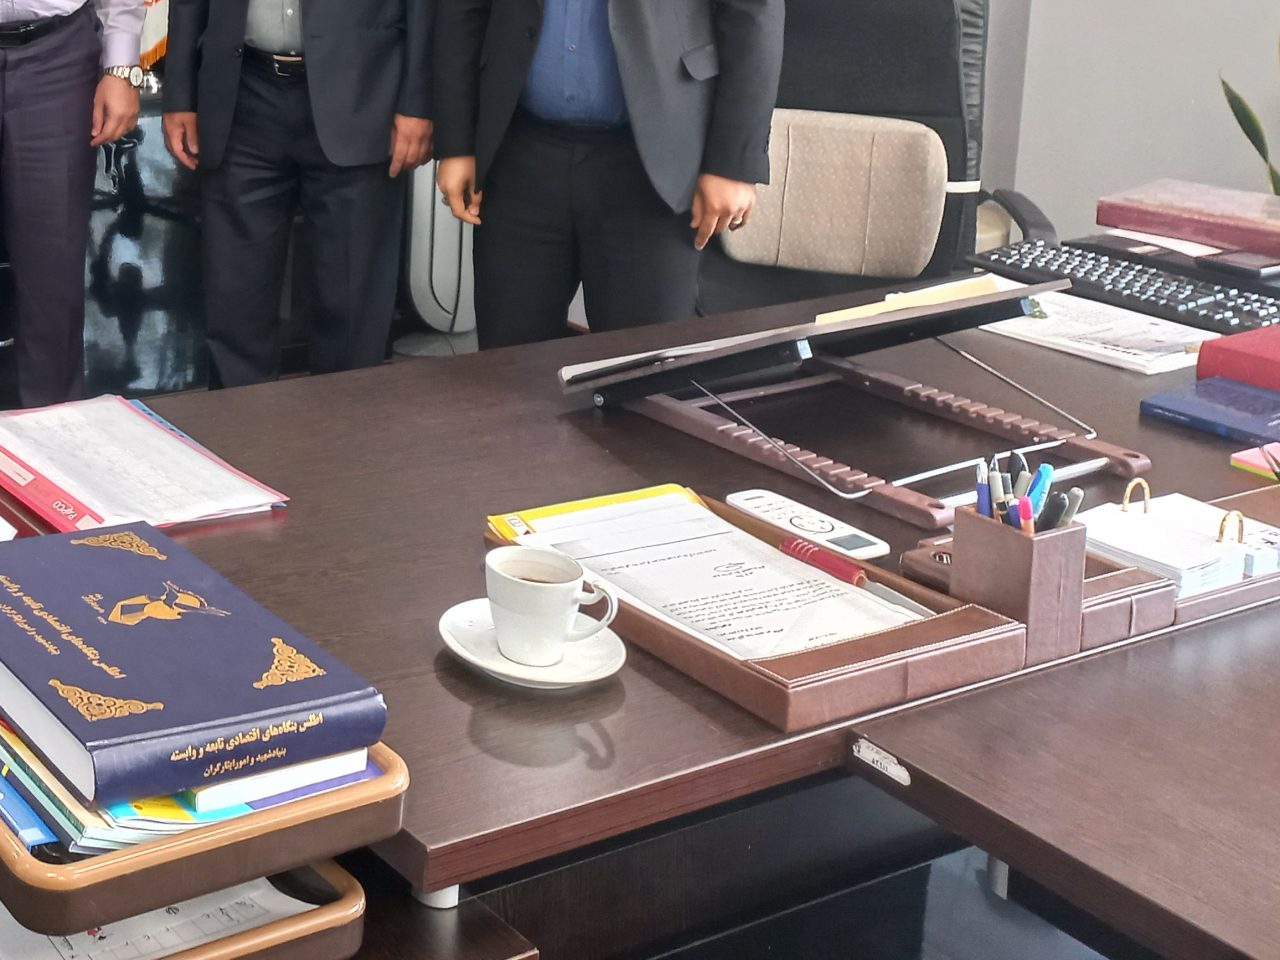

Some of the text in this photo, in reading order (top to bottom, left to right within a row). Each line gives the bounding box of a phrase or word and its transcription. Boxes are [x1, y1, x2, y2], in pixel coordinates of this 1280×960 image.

[53, 500, 77, 520] PAPCO
[299, 711, 324, 733] اطلس
[205, 737, 224, 753] تابعه
[226, 727, 260, 751] اقتصادی
[170, 744, 197, 762] وابسته
[198, 746, 204, 759] و
[250, 755, 255, 766] و
